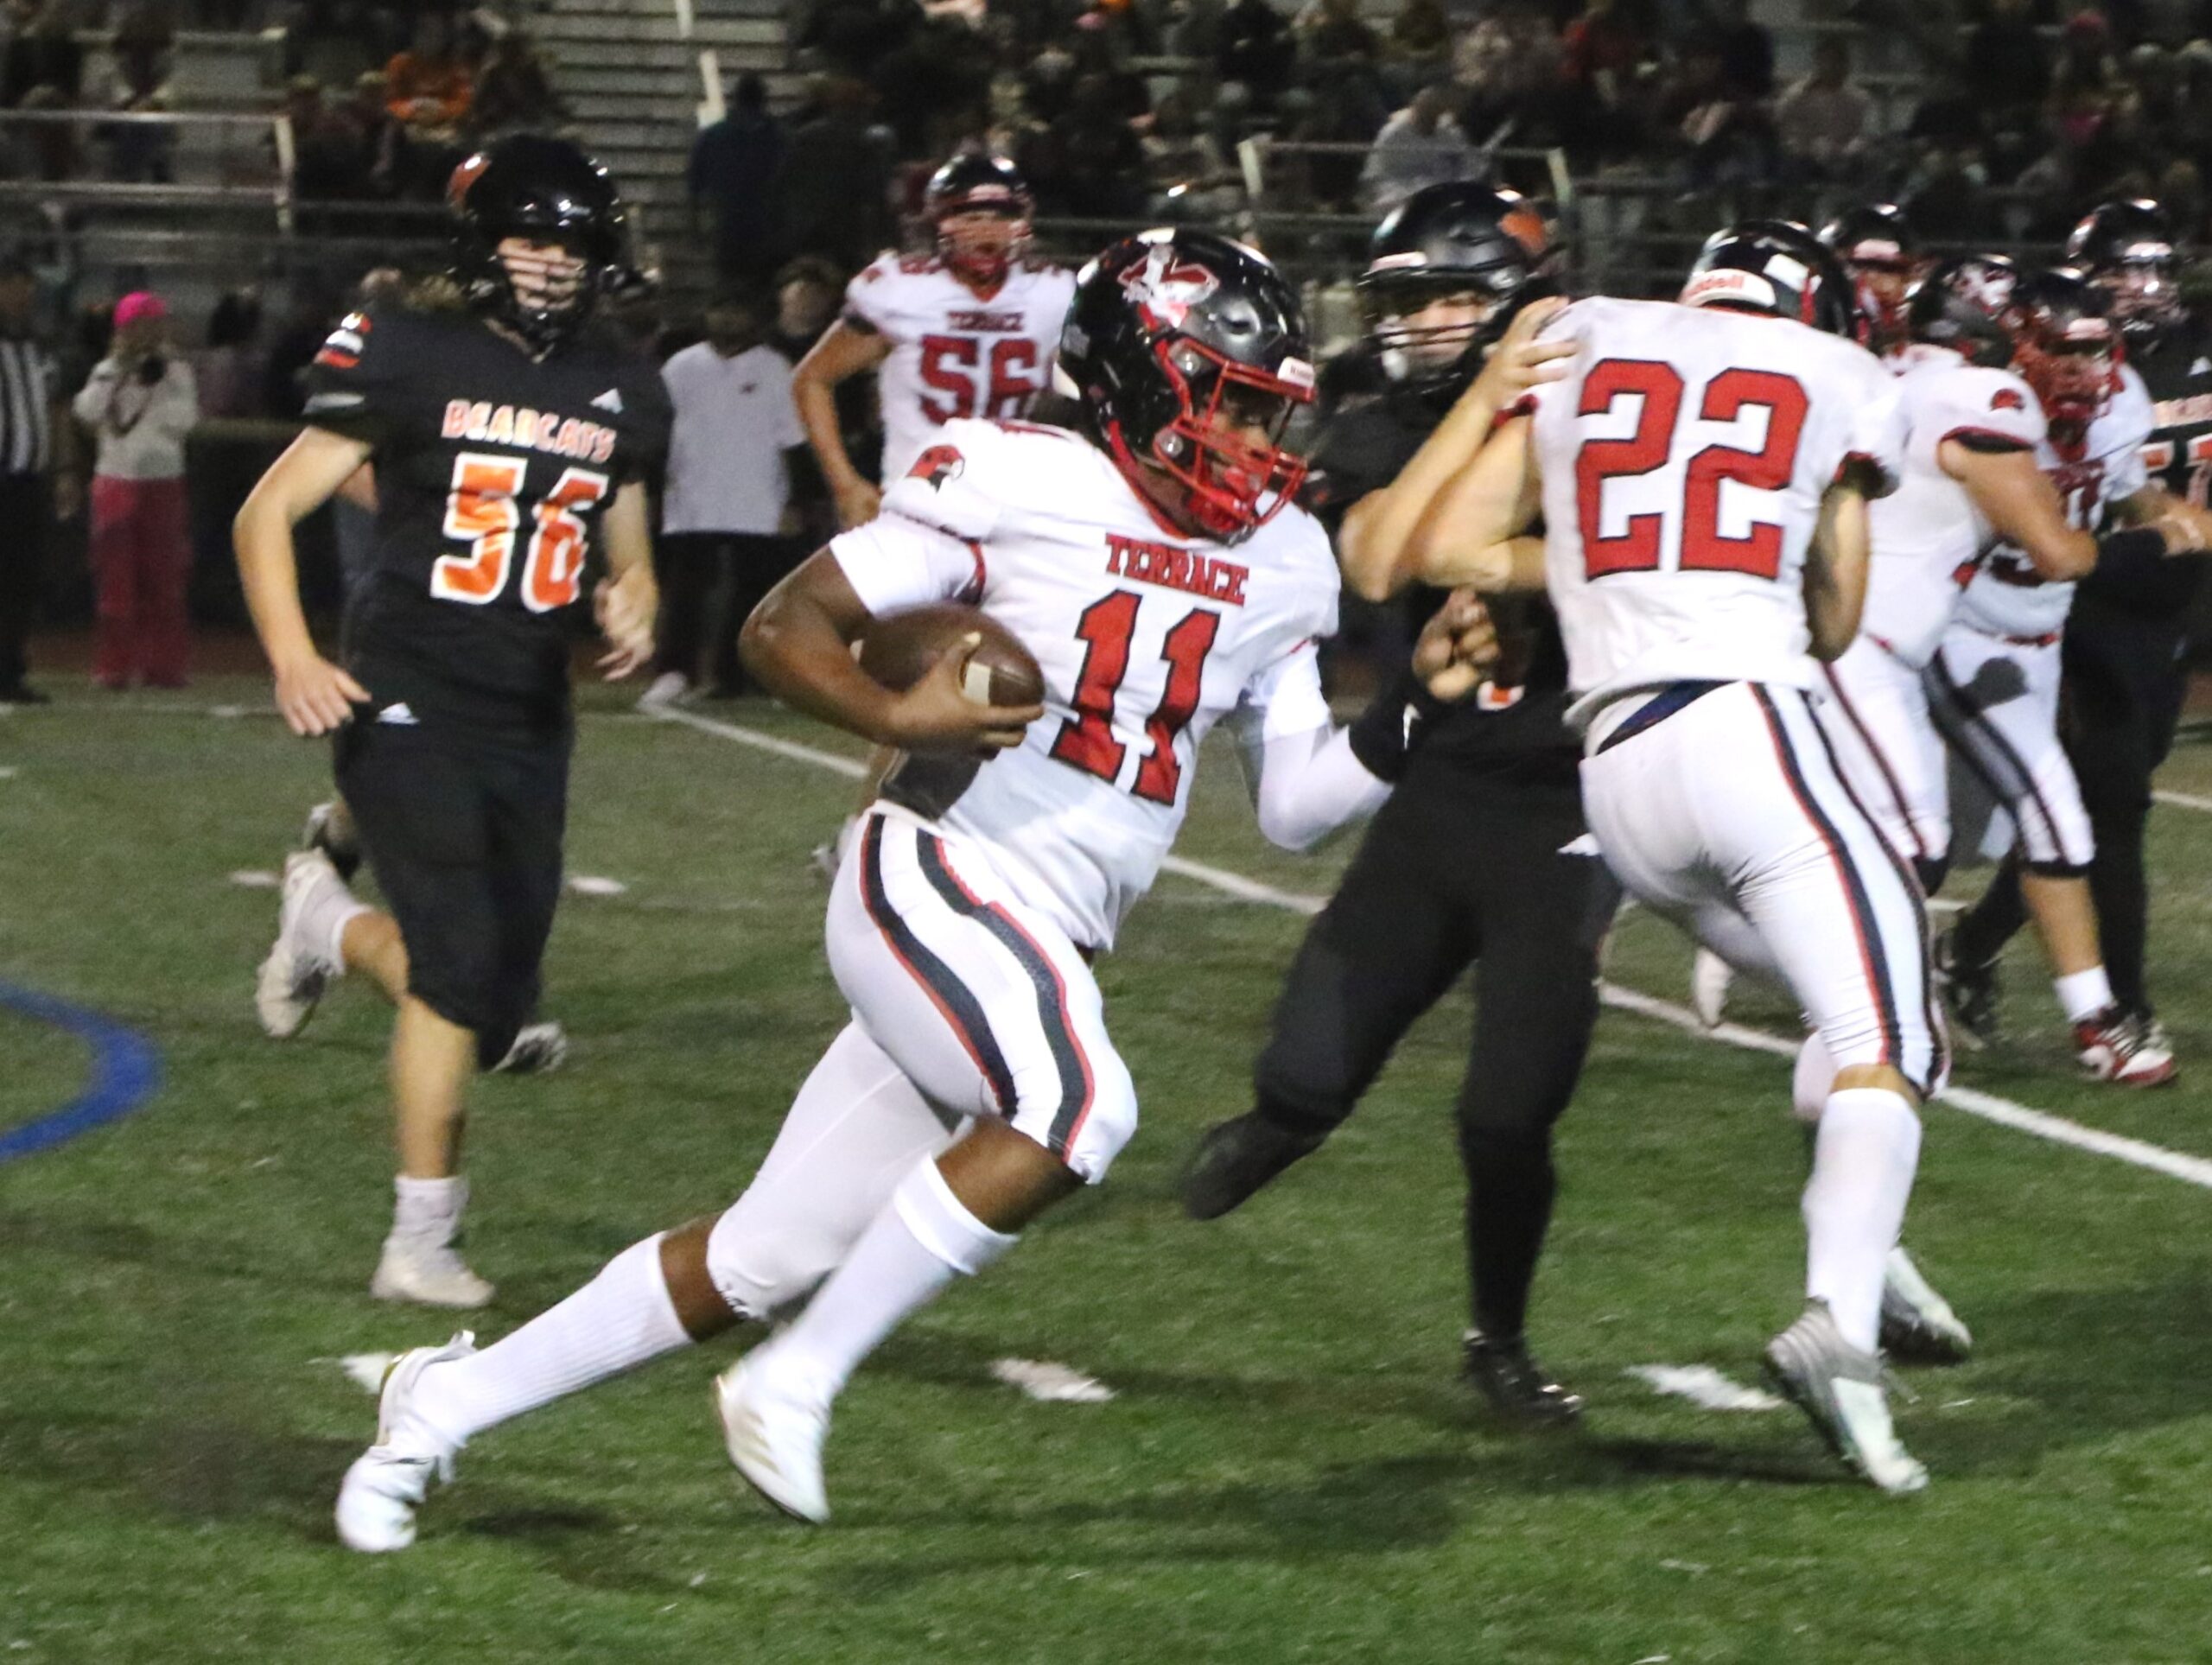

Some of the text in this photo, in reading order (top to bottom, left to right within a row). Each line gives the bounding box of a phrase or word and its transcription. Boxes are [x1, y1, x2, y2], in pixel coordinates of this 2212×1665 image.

[441, 399, 617, 464] BEARCATS
[920, 334, 1037, 425] 56
[430, 452, 609, 613] 56
[1575, 358, 1809, 582] 22
[1105, 532, 1249, 608] TERRACE
[1048, 588, 1222, 807] 11
